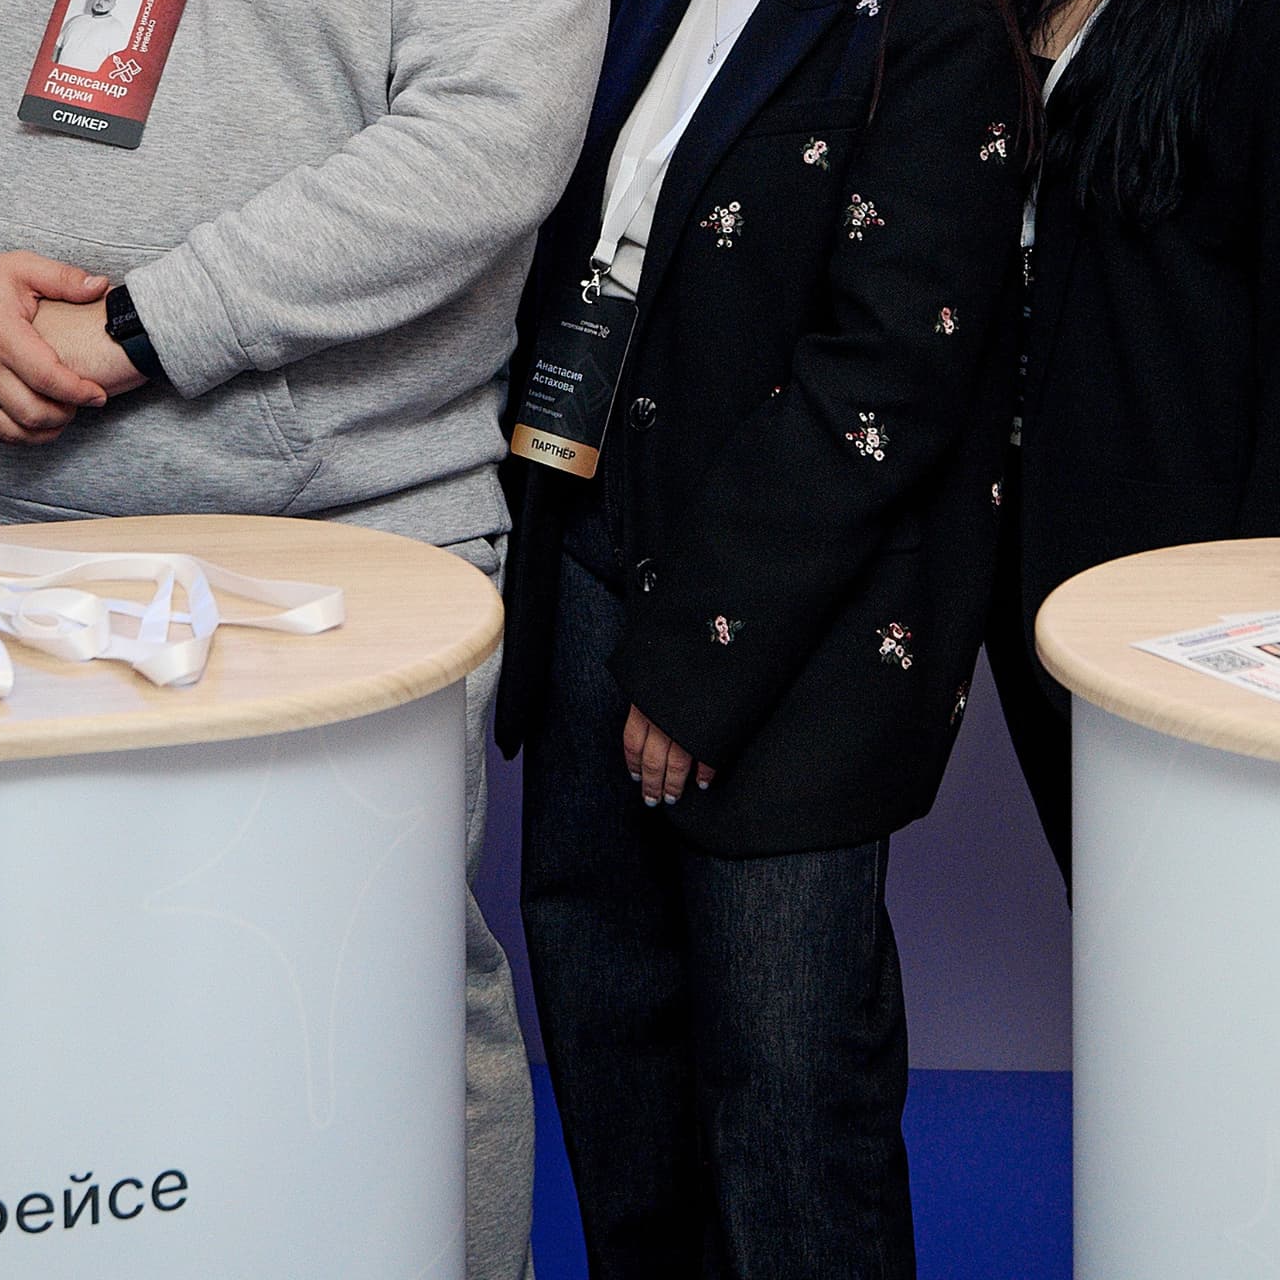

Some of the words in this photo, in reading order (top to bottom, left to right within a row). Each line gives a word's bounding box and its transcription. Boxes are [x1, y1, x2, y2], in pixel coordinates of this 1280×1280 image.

[44, 80, 93, 103] Пиджи
[48, 67, 128, 99] Александр
[52, 110, 109, 132] СПИКЕР
[535, 359, 584, 382] Анастасия
[532, 371, 575, 393] Астахова
[531, 438, 577, 460] ПАРТНЁР
